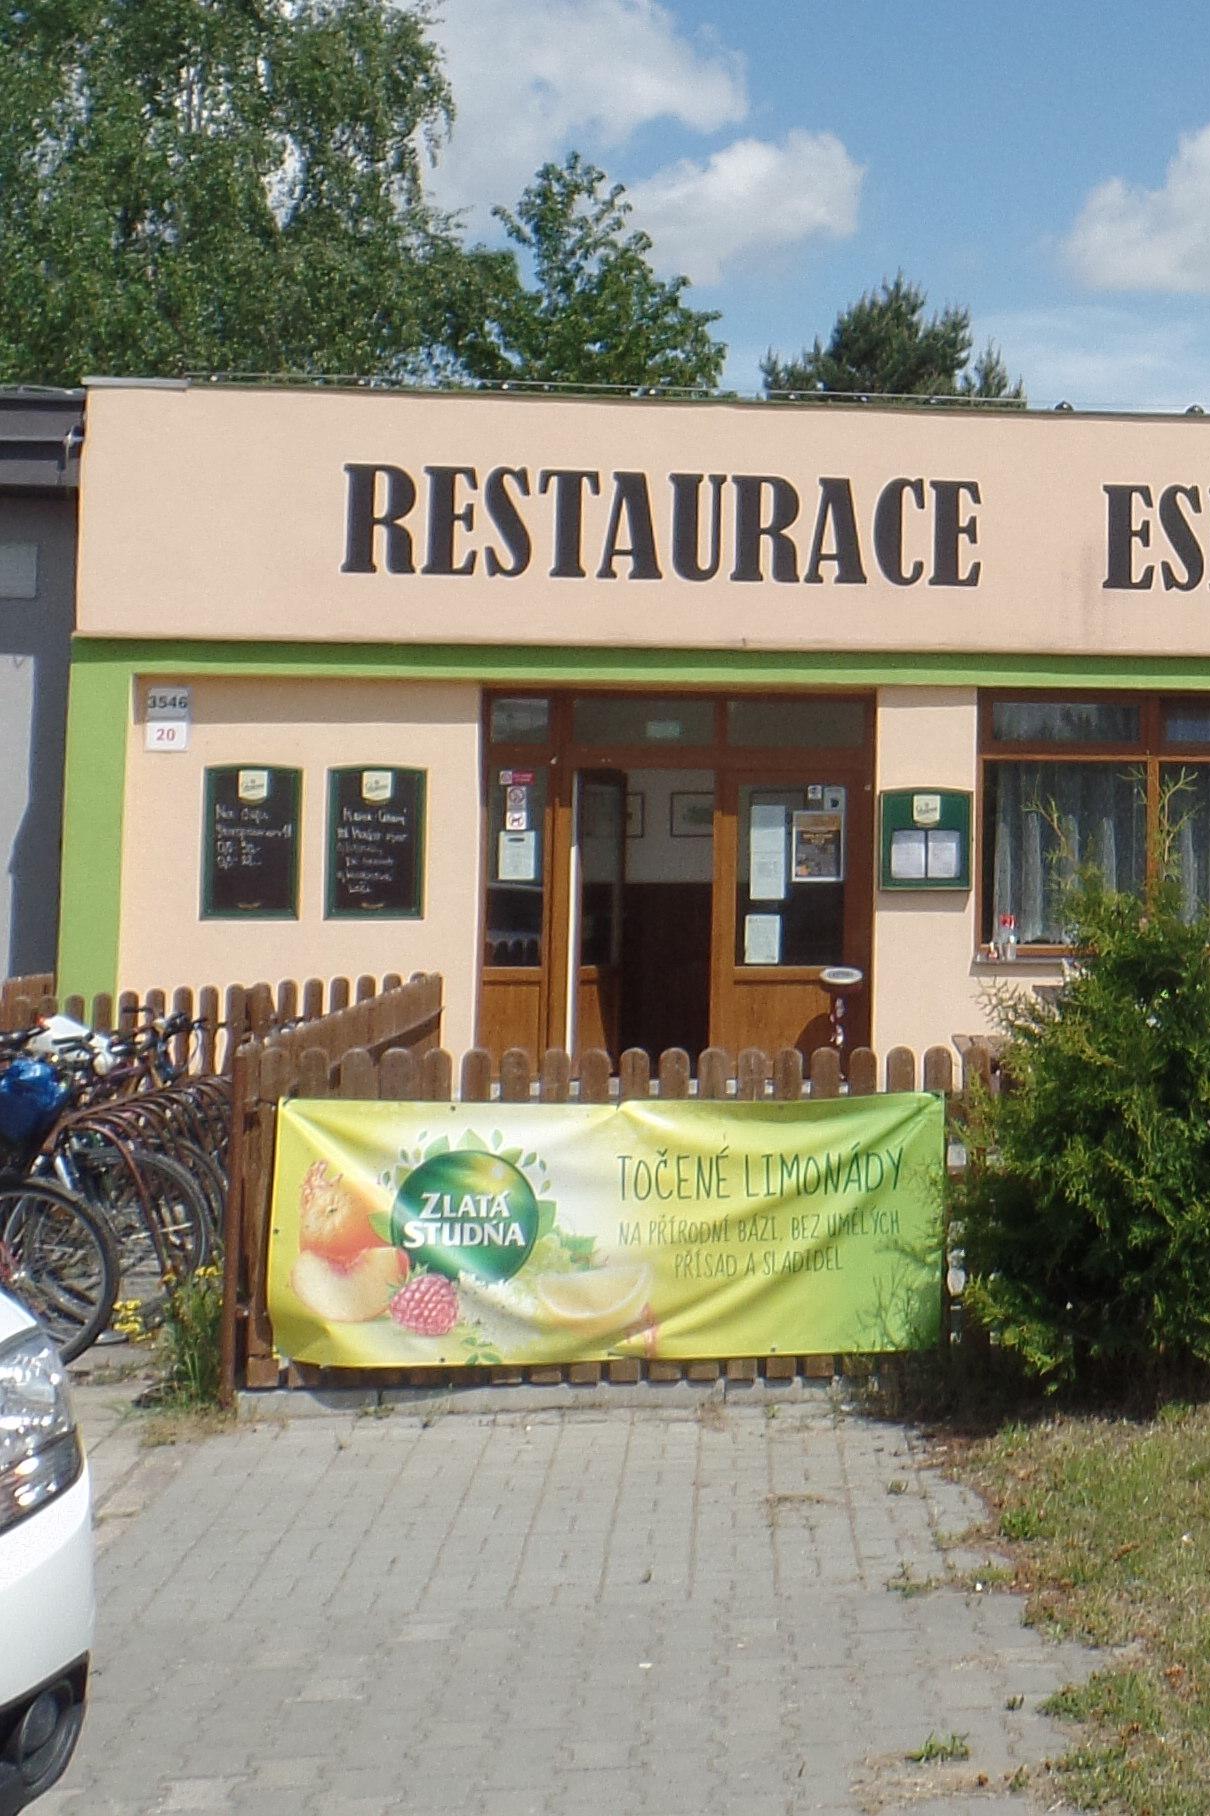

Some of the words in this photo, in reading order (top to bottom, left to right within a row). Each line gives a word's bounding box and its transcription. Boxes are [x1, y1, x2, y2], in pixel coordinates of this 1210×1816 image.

[340, 462, 982, 587] RESTAURACE
[148, 695, 188, 709] 3546
[156, 728, 176, 742] 20
[617, 1145, 730, 1200] TOČENÉ
[745, 1142, 903, 1197] LIMONÁDY
[418, 1190, 512, 1220] ZLATÁ
[618, 1221, 641, 1247] NA
[648, 1214, 730, 1246] PŘÍRODNÍ
[791, 1213, 820, 1241] BEZ
[674, 1248, 738, 1278] PŘÍSAD
[744, 1252, 756, 1276] A
[762, 1245, 844, 1275] SLADIDEL
